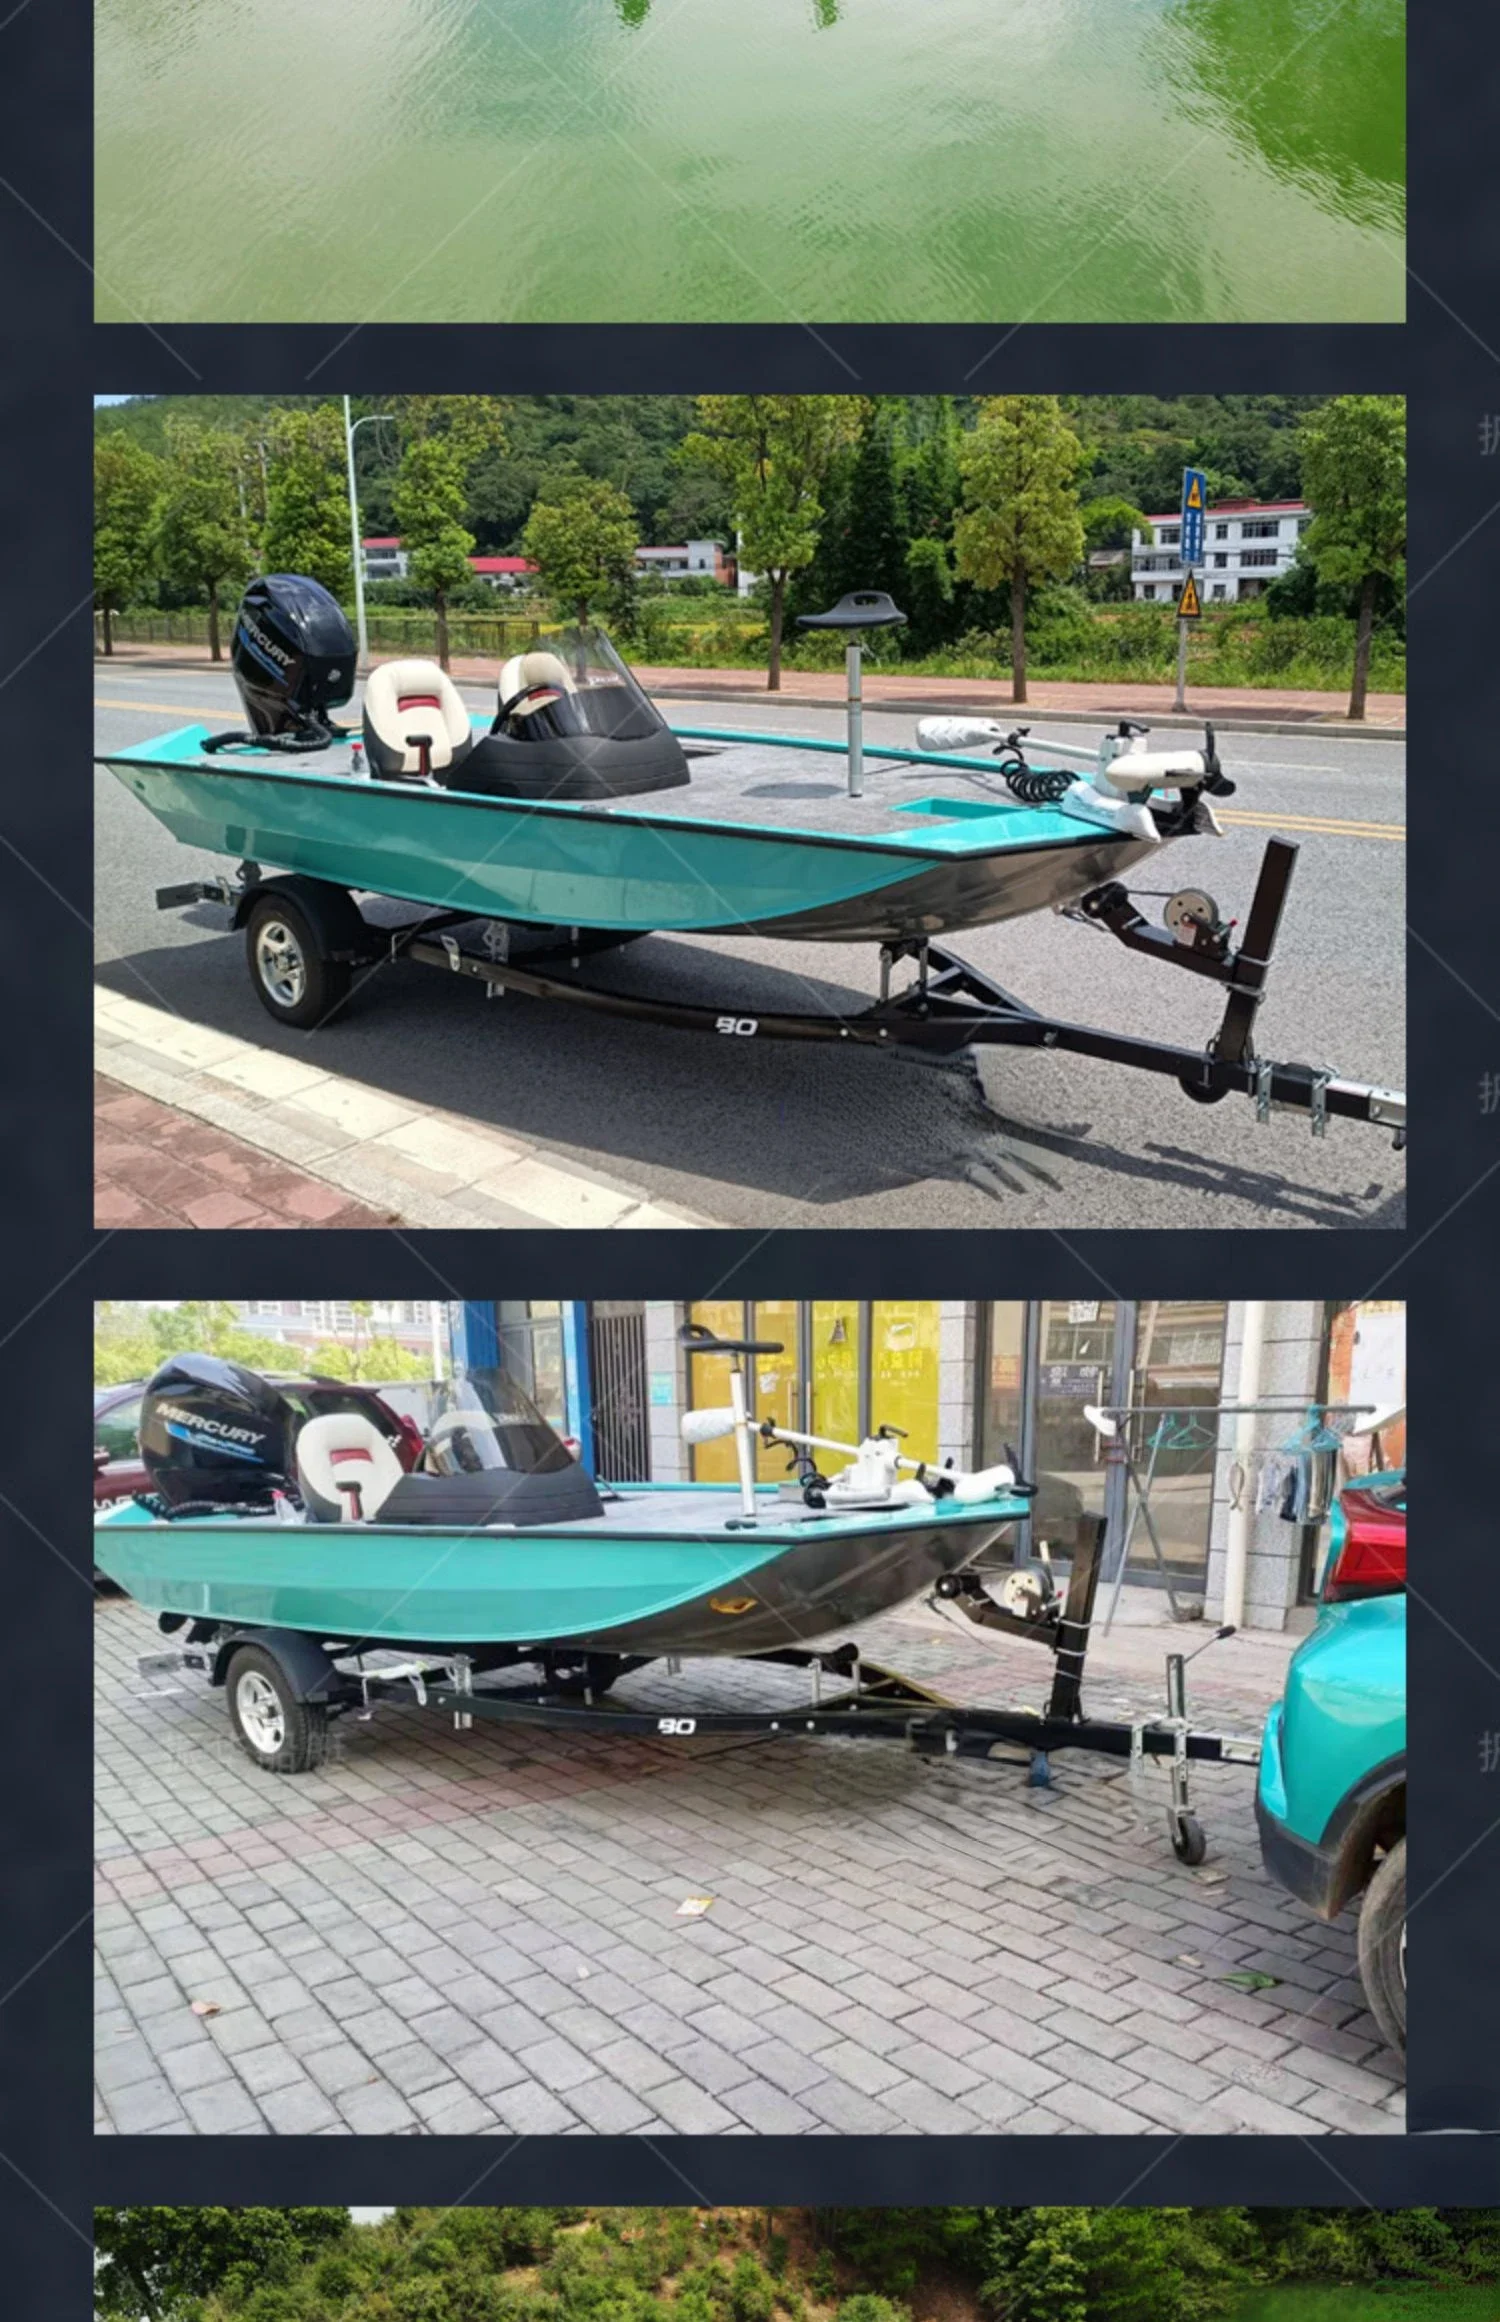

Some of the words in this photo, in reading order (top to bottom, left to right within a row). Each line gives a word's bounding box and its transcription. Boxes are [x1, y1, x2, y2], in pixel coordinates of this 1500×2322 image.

[714, 1015, 759, 1036] 90
[156, 1402, 266, 1444] MERCURY
[658, 1717, 696, 1735] 90
